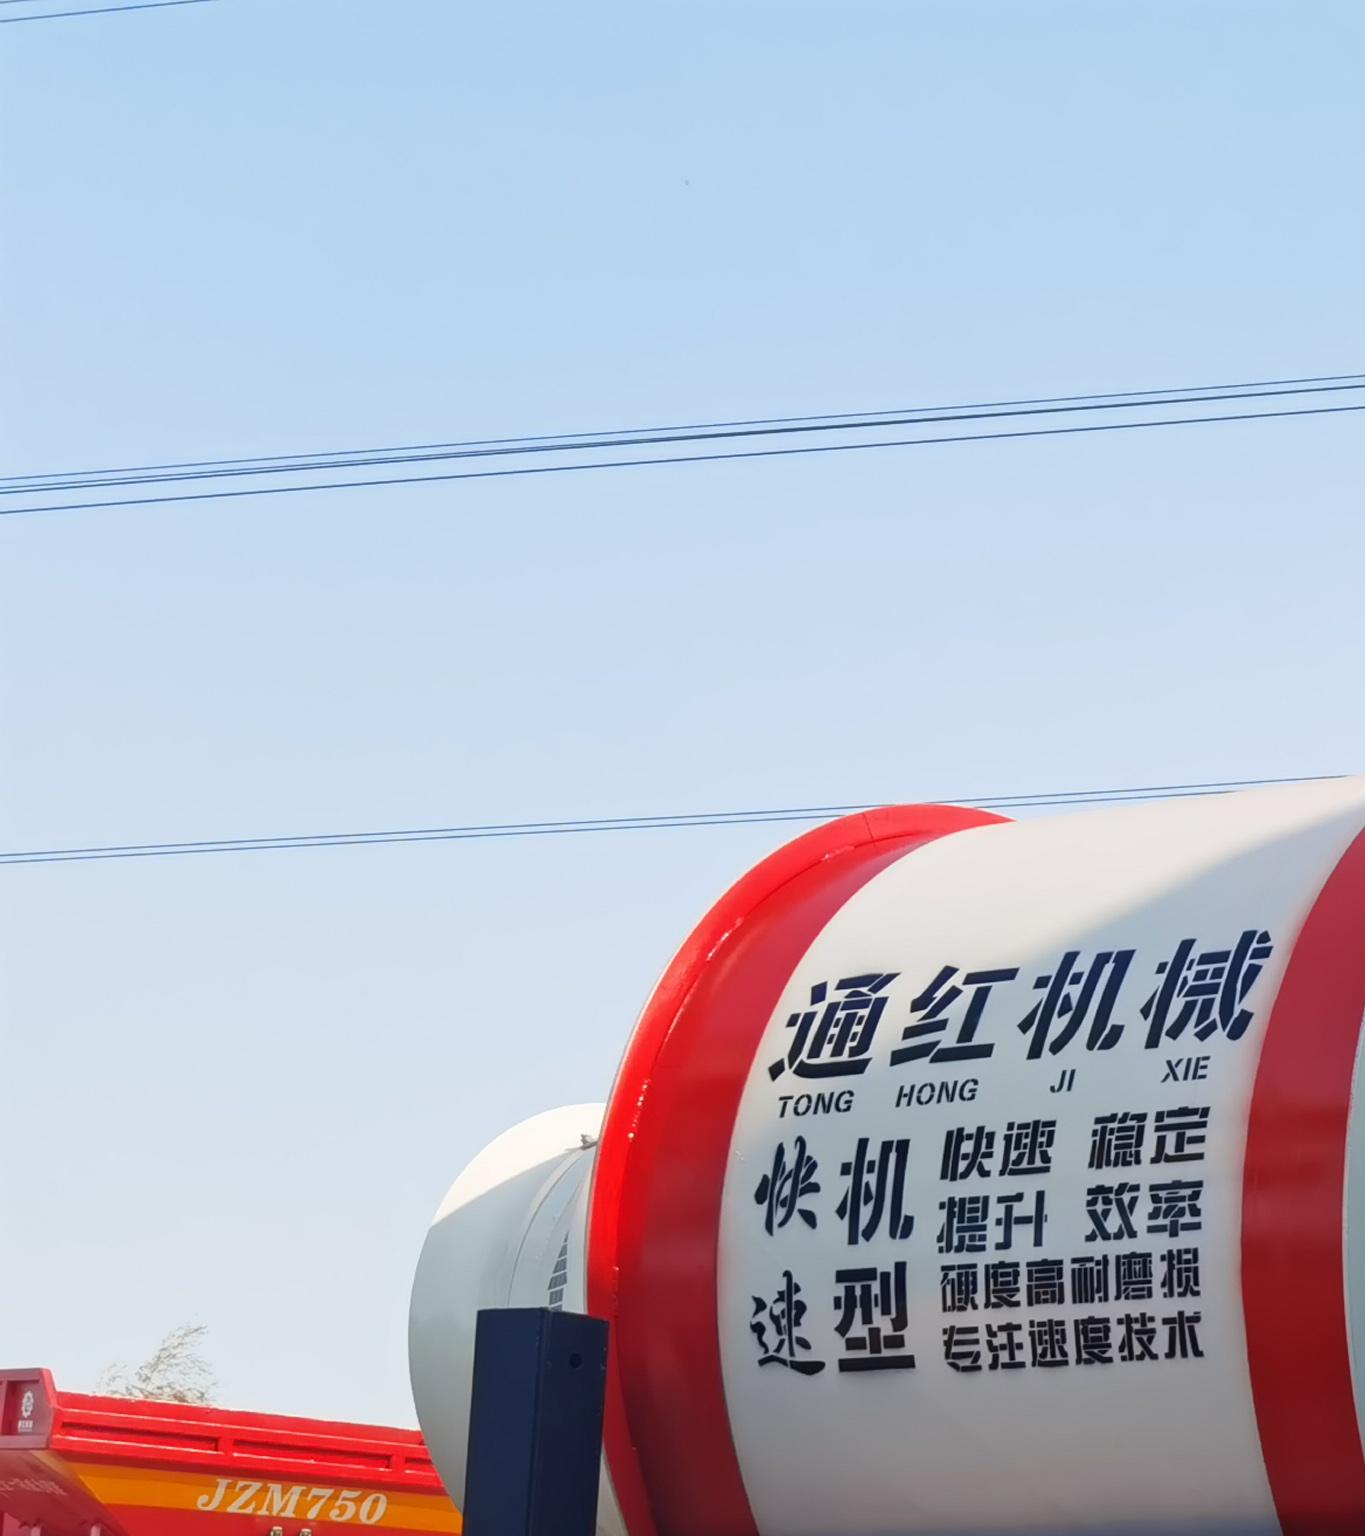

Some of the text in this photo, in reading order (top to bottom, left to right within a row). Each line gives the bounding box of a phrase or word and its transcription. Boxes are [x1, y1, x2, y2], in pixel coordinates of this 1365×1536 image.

[767, 929, 1274, 1083] 通红机械
[777, 1054, 1211, 1119] TONG HONG JI XIE
[938, 1105, 1211, 1182] 快速 稳定
[935, 1179, 1204, 1254] 提升 效率
[939, 1246, 1202, 1312] 硬度高耐磨损
[941, 1309, 1206, 1374] 专注速度技术
[196, 1477, 388, 1527] JZM750
